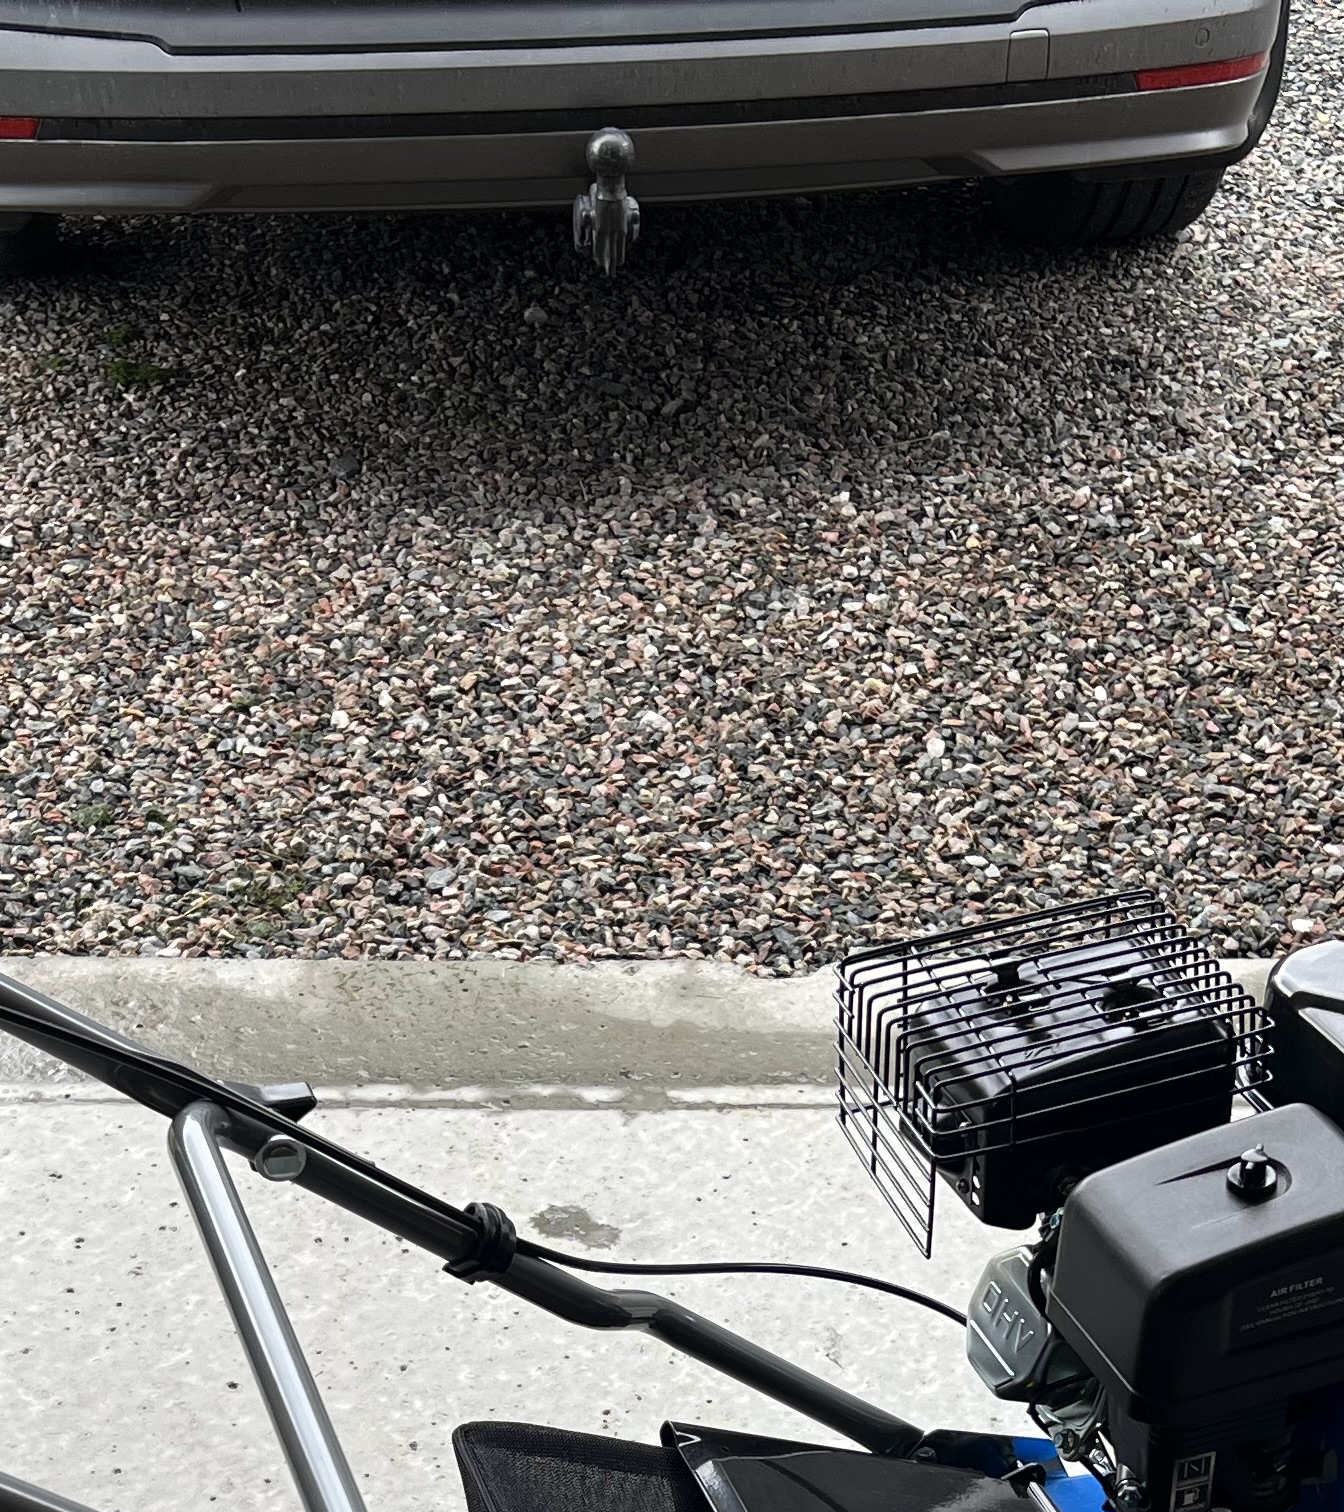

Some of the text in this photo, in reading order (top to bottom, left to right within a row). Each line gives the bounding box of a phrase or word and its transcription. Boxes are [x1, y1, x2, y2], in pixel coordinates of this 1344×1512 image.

[1269, 1286, 1289, 1298] AIR
[1288, 1277, 1324, 1293] FILTER
[981, 1280, 1034, 1355] OHV
